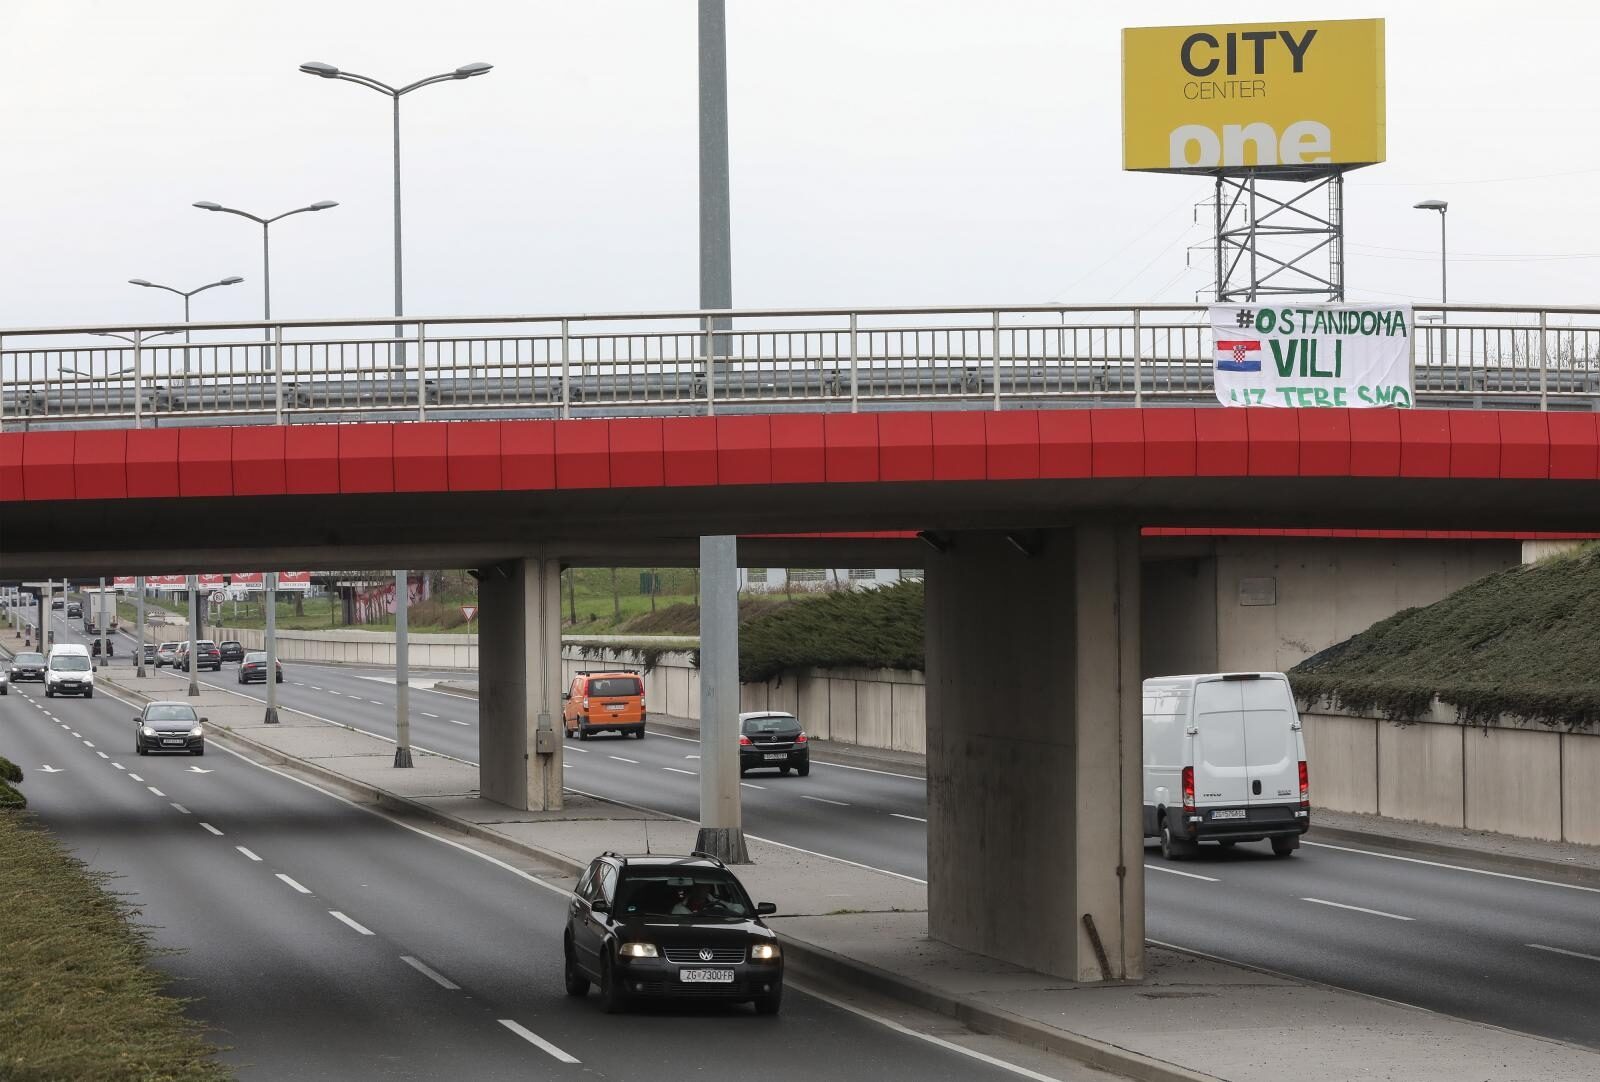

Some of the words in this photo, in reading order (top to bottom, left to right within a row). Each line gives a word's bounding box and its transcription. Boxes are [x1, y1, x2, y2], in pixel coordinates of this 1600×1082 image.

[1181, 30, 1317, 76] CITY
[1183, 79, 1266, 100] CENTER
[1169, 120, 1331, 168] one
[1236, 308, 1407, 338] #OSTANIDOMA
[1268, 338, 1342, 378] VILI
